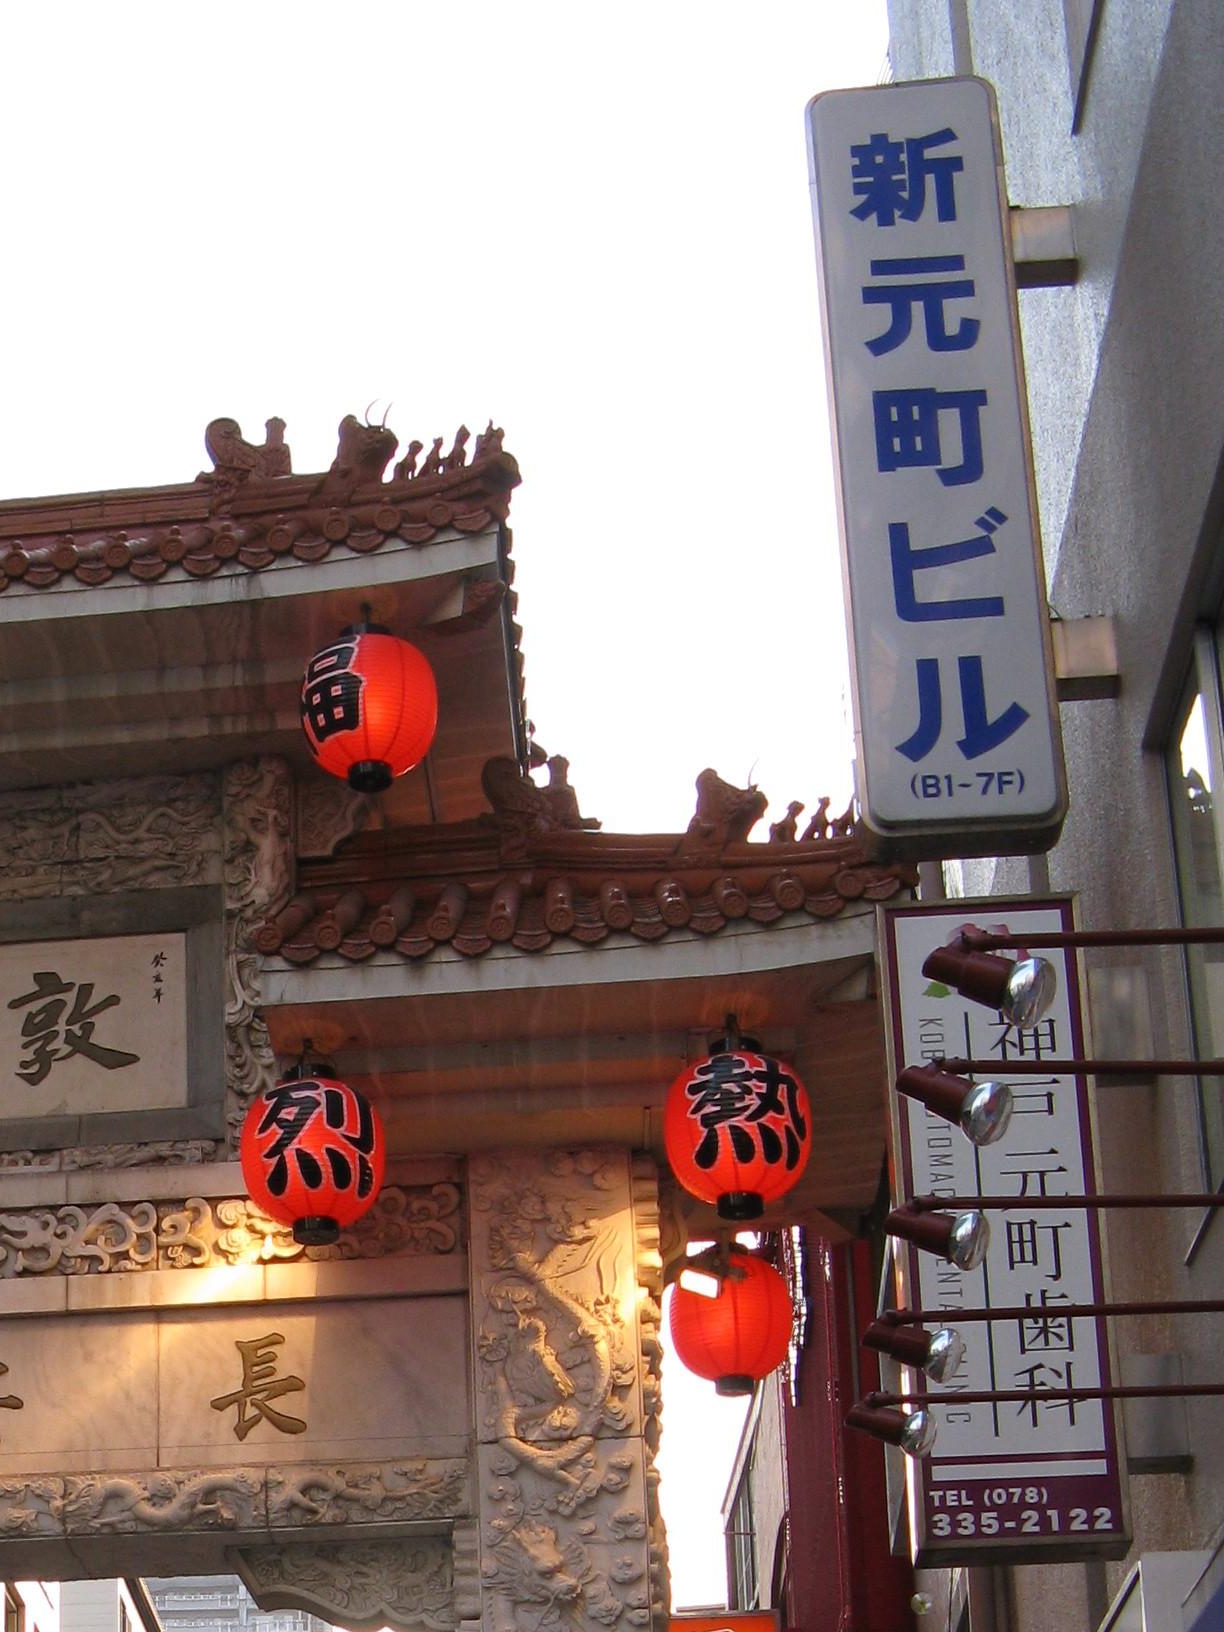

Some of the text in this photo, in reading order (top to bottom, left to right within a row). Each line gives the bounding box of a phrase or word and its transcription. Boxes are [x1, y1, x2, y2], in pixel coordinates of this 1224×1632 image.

[847, 128, 1030, 763] 新元町ビル
[255, 1079, 382, 1200] 烈
[686, 1054, 809, 1171] 熱
[929, 1486, 1049, 1506] TEL (078)
[930, 1507, 1114, 1537] 335-2122
